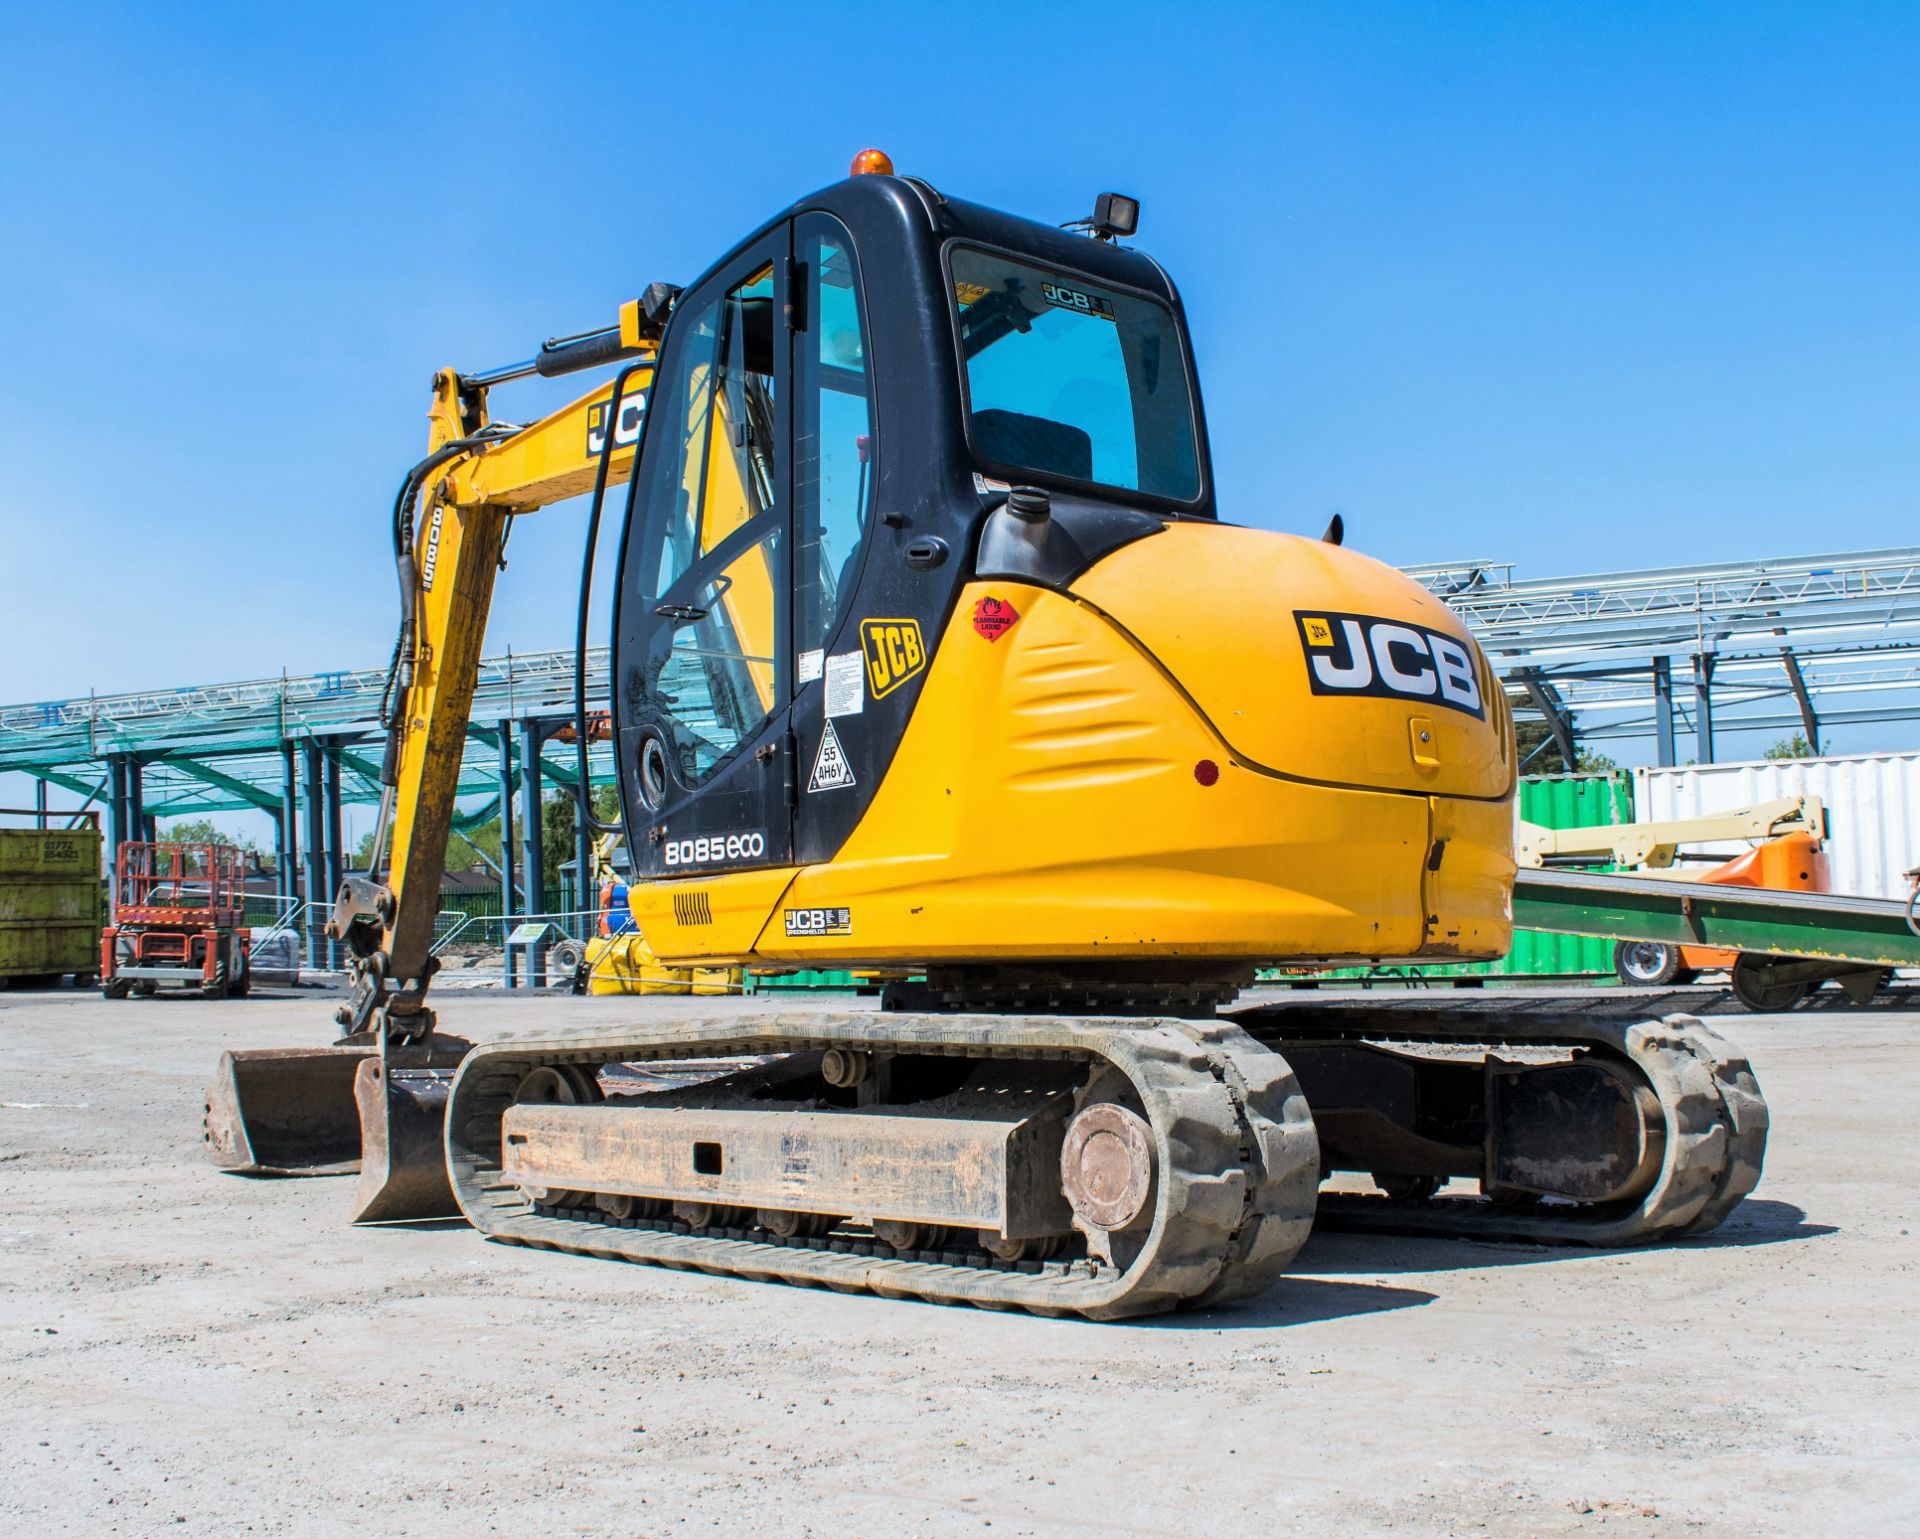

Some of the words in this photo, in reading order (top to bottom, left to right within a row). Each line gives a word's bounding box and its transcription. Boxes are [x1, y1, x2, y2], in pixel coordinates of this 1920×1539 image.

[1045, 286, 1089, 308] JCB
[588, 394, 646, 452] JC
[870, 626, 920, 690] JCB
[1311, 619, 1481, 710] JCB
[824, 746, 836, 762] 55
[44, 841, 73, 849] 01772
[785, 910, 826, 929] JCB
